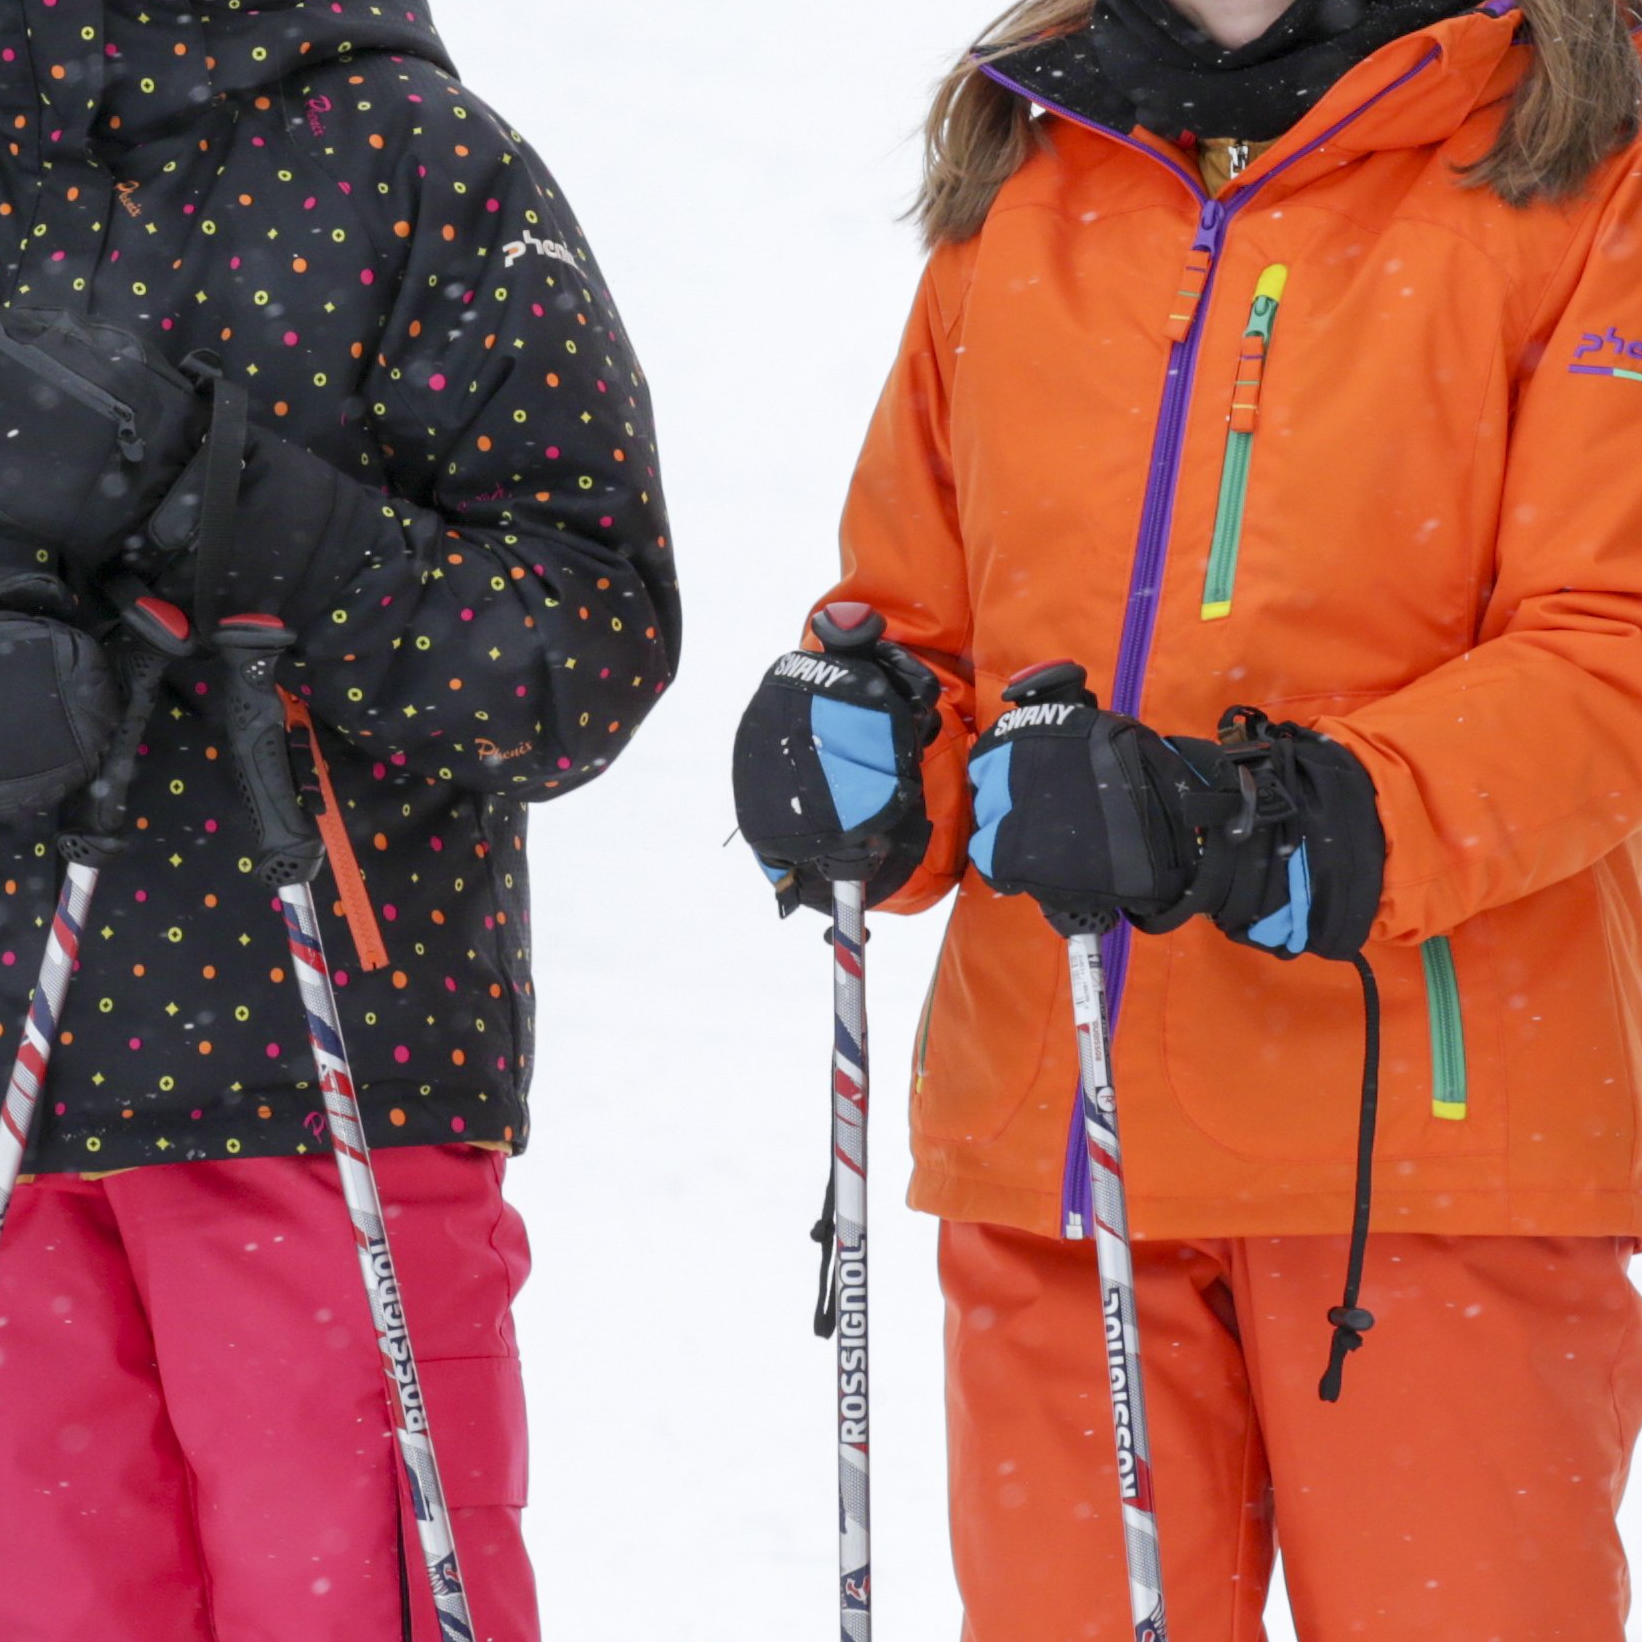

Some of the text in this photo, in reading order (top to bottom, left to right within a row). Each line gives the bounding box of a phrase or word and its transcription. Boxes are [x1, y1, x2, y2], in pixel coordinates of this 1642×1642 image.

[774, 653, 849, 688] SWANY
[994, 703, 1075, 737] SWANY
[840, 1234, 867, 1444] ROSSIGNOL
